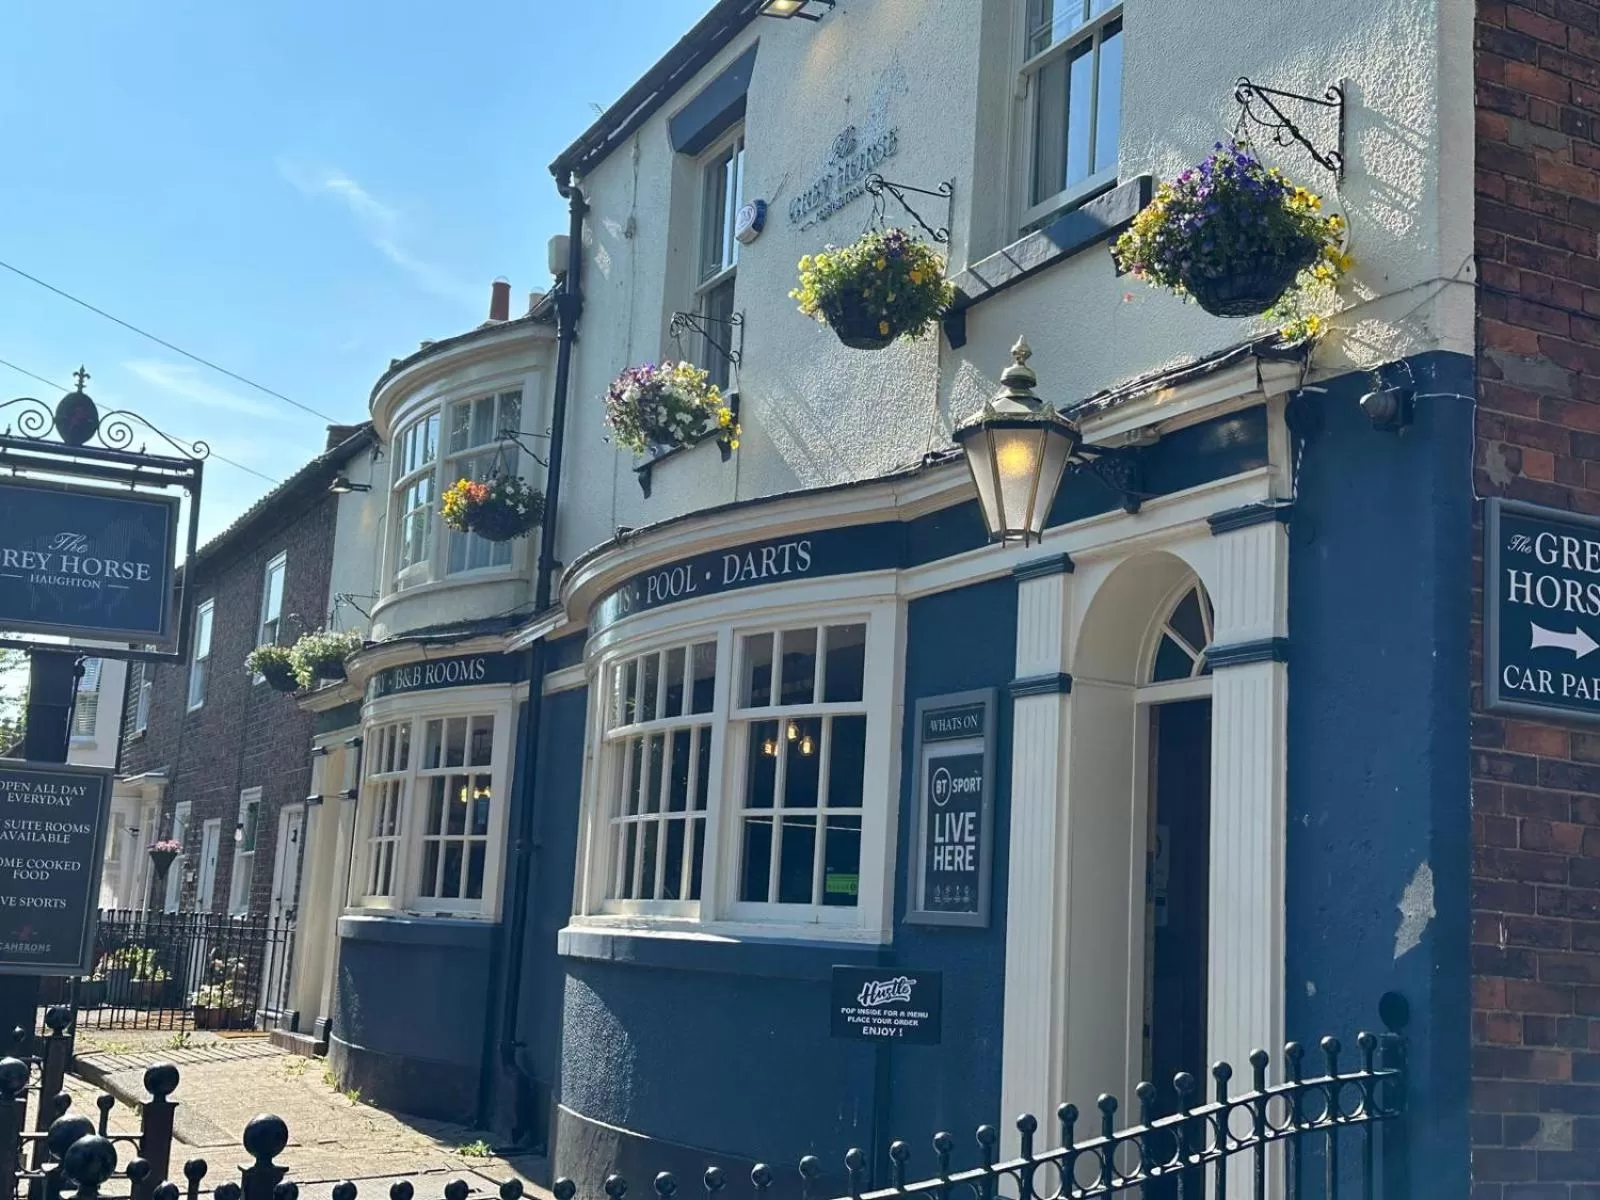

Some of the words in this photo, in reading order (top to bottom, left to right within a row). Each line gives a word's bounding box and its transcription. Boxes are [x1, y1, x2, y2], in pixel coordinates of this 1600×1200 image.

[48, 532, 89, 553] The
[1507, 534, 1532, 554] The
[1535, 532, 1600, 573] GRE
[0, 548, 52, 571] REY
[61, 555, 151, 581] HORSE
[646, 564, 697, 604] POOL
[722, 540, 812, 585] DARTS
[30, 573, 100, 589] HAUGHTON
[395, 664, 421, 689] B&B
[425, 658, 485, 685] ROOMS
[1503, 664, 1554, 694] CAR
[930, 716, 962, 732] WHATS
[963, 713, 978, 729] ON
[34, 783, 58, 795] ALL
[61, 785, 87, 797] DAY
[935, 779, 948, 795] BT
[952, 775, 982, 793] SPORT
[8, 792, 73, 806] EVERYDAY
[4, 819, 42, 831] SUITE
[45, 821, 91, 834] ROOMS
[934, 812, 976, 844] LIVE
[0, 830, 71, 844] AVAILABLE
[26, 858, 81, 871] COOKED
[933, 845, 975, 872] HERE
[13, 869, 50, 880] FOOD
[19, 896, 67, 908] SPORTS
[847, 1016, 870, 1024] PLACE
[872, 1017, 892, 1025] YOUR
[857, 1008, 881, 1016] INSIDE
[883, 1009, 898, 1017] FOR
[907, 1010, 928, 1018] MENU
[862, 1026, 896, 1036] ENJOY
